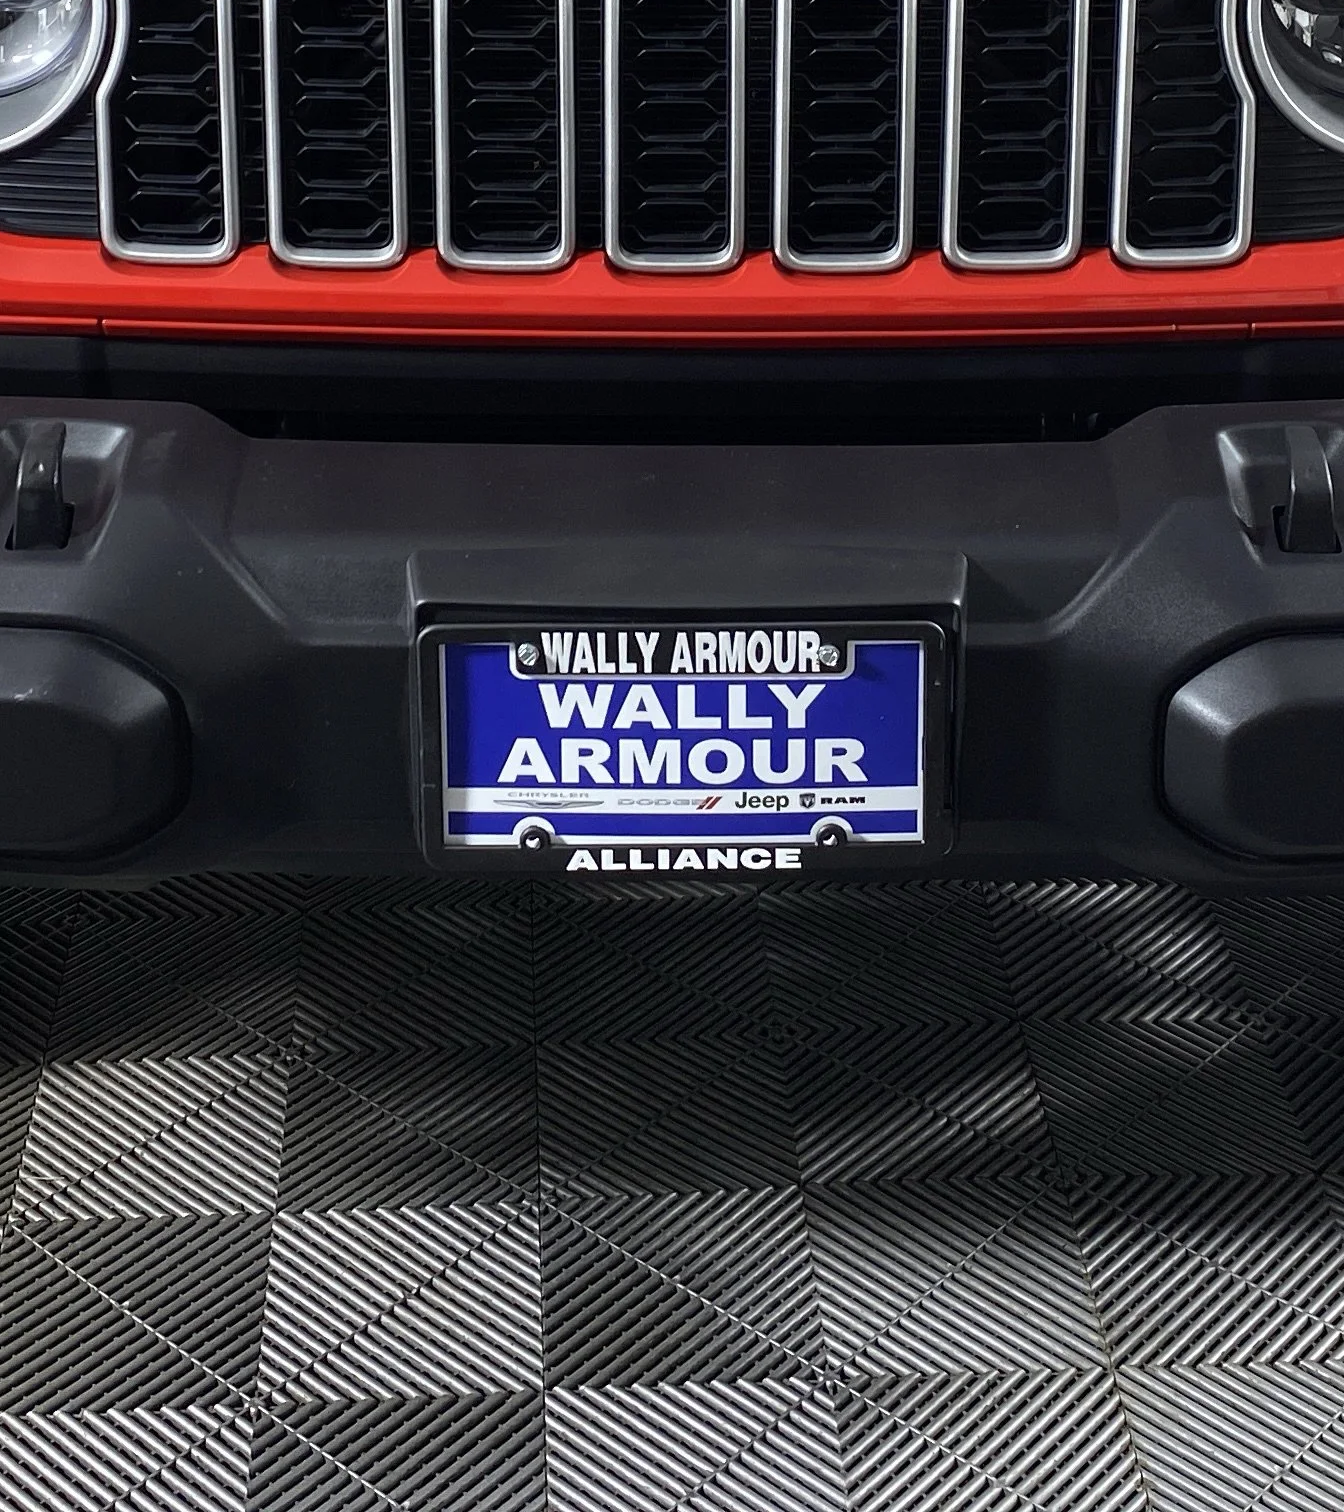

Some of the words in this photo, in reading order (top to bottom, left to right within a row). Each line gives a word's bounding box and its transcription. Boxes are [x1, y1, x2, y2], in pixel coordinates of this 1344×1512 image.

[540, 631, 660, 674] WALLY
[669, 630, 822, 674] ARMOUR
[537, 683, 827, 729] WALLY
[496, 737, 870, 785] ARMOUR
[734, 791, 790, 812] Jeep
[819, 796, 867, 805] RAM
[565, 848, 803, 872] ALLIANCE
